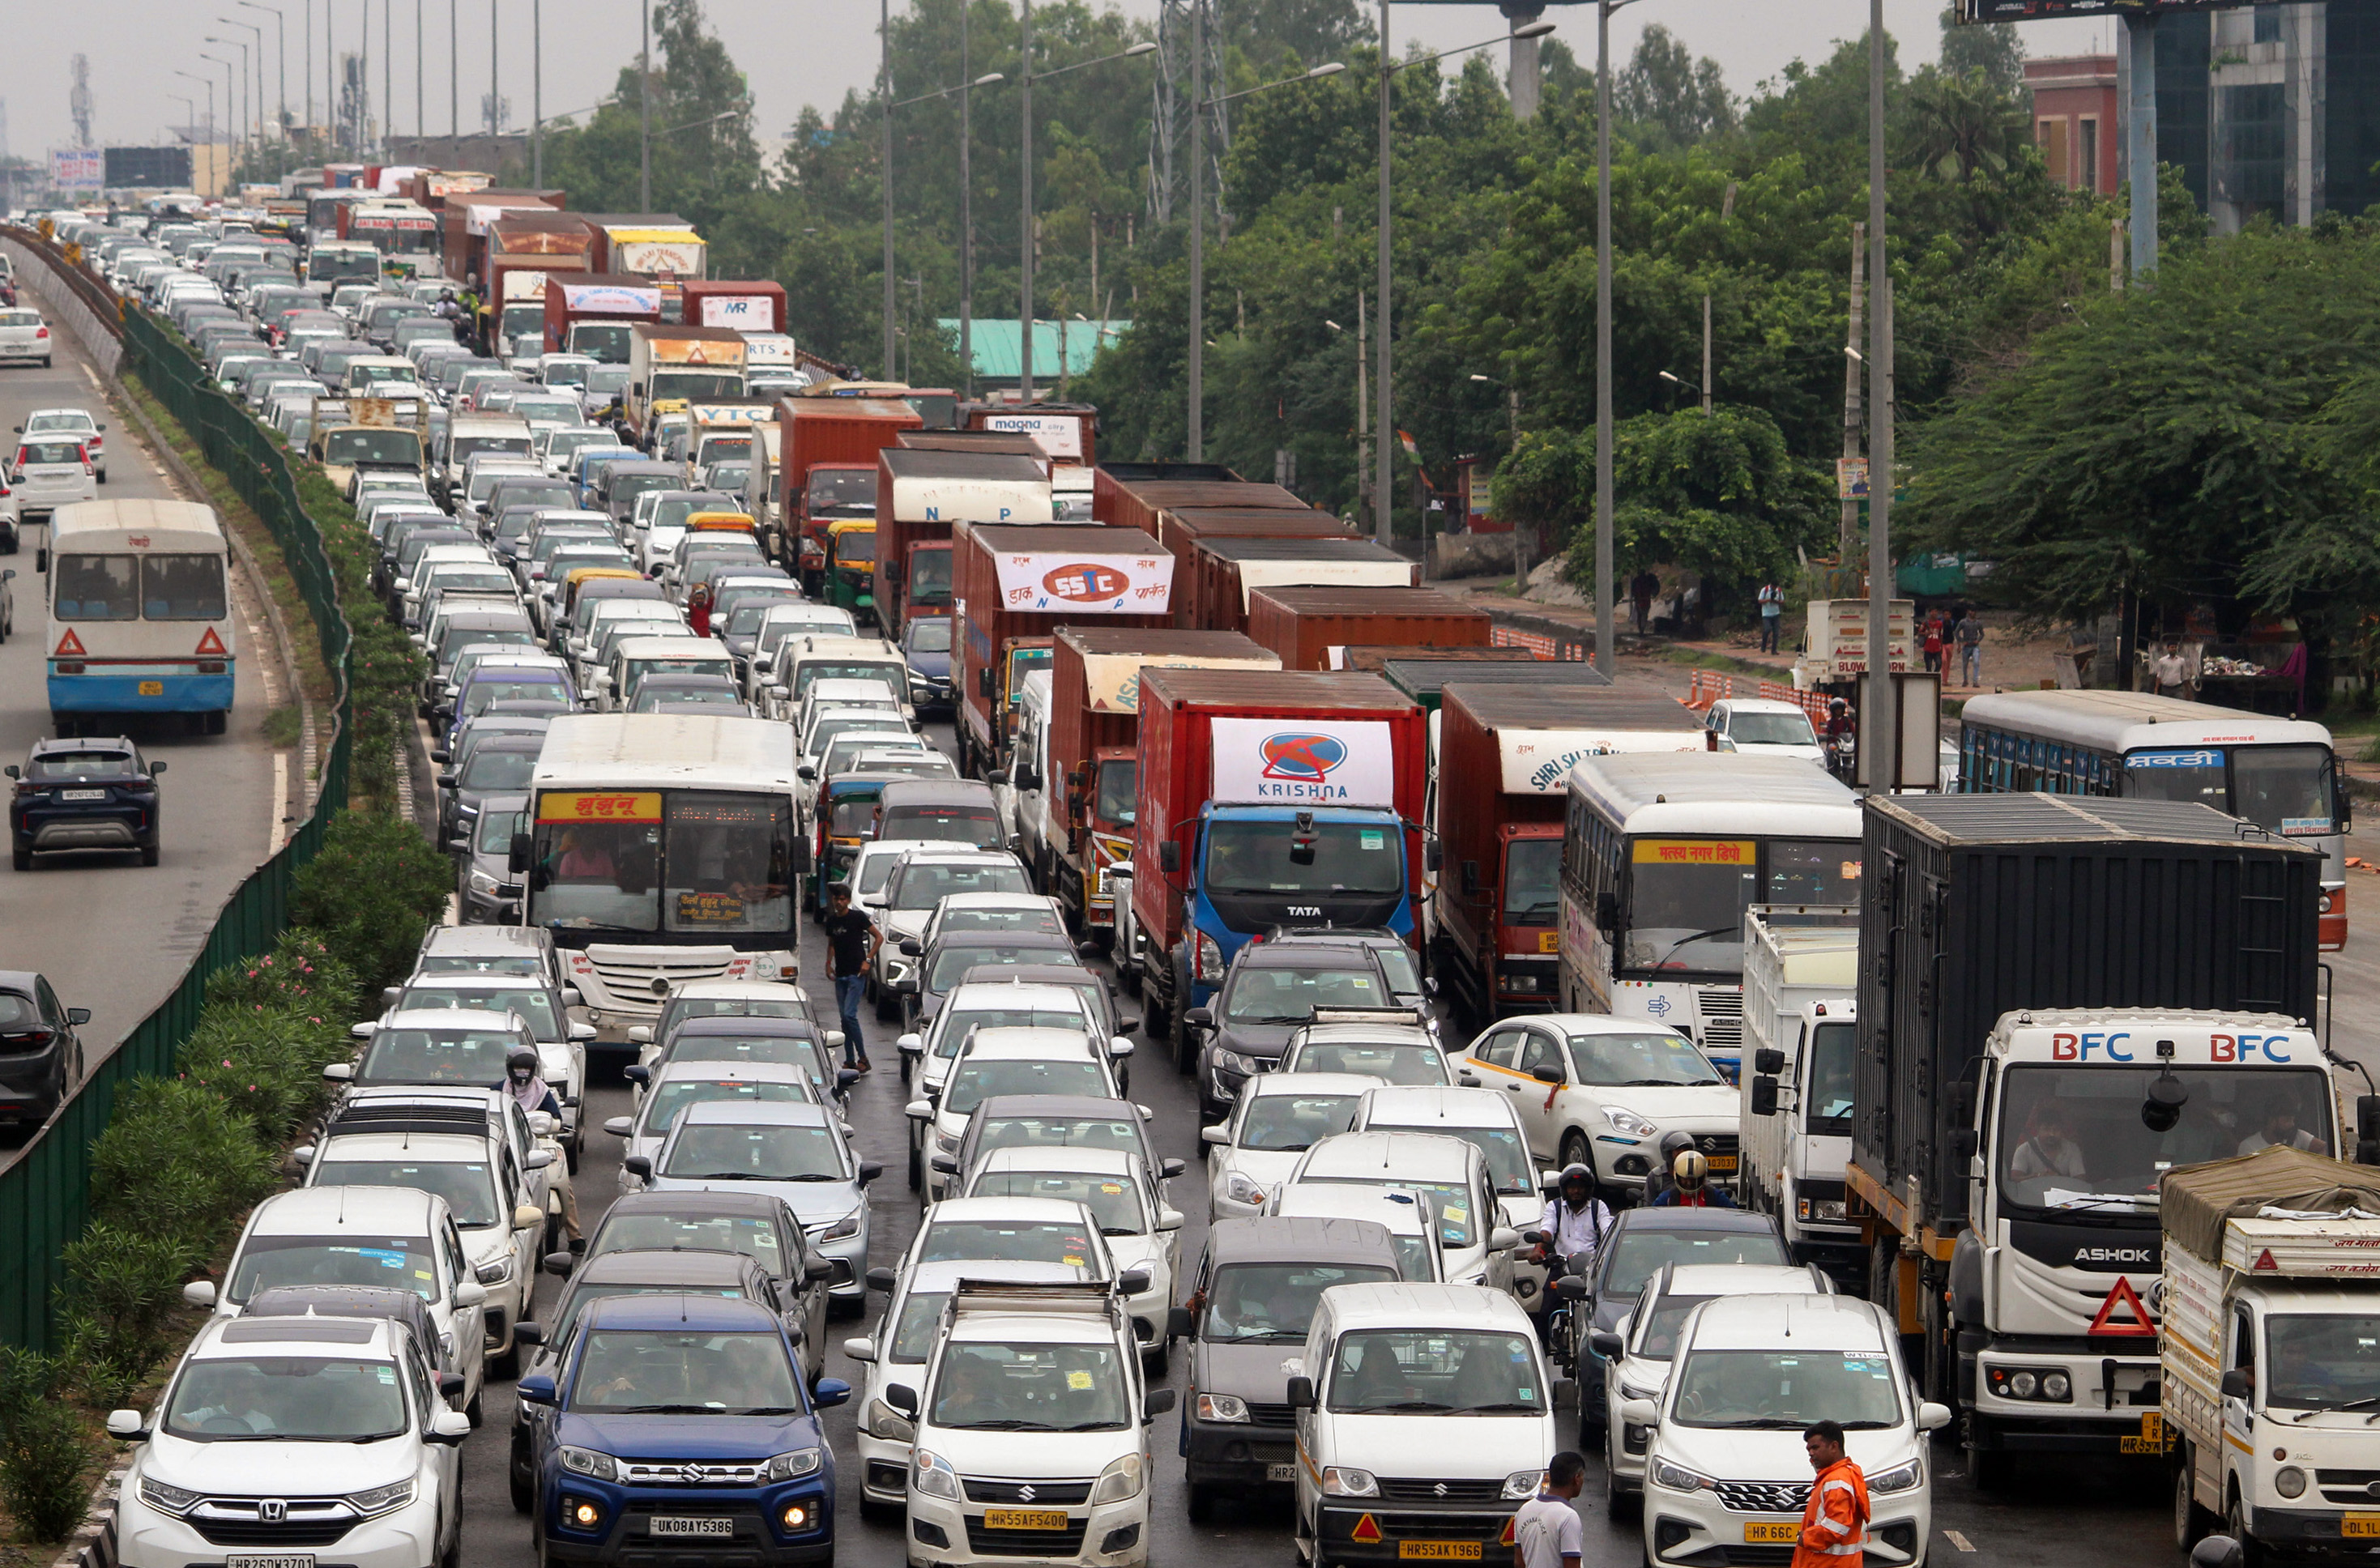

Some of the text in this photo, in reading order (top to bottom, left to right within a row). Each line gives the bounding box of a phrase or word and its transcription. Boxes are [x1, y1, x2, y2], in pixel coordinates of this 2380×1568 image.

[702, 408, 764, 420] YTC
[995, 420, 1041, 432] magna
[926, 507, 1012, 522] N P
[1137, 559, 1157, 570] लाभ
[1055, 570, 1115, 597] SSTC
[1009, 582, 1167, 605] डाक पार्सल
[1036, 597, 1124, 609] N P
[1838, 661, 1905, 672] BLOW RN
[1530, 758, 1564, 792] SHRI
[1258, 783, 1349, 799] KRISHNA
[1689, 845, 1713, 862] नगर
[1716, 842, 1742, 863] डिपो
[1286, 906, 1322, 918] TATA
[2053, 1033, 2292, 1063] BFC BFC
[2074, 1248, 2151, 1263] ASHOK
[658, 1519, 732, 1533] UK08AY5386
[992, 1513, 1066, 1528] HR55AF5400
[1753, 1526, 1793, 1539] HR 66C
[2350, 1522, 2364, 1534] DL
